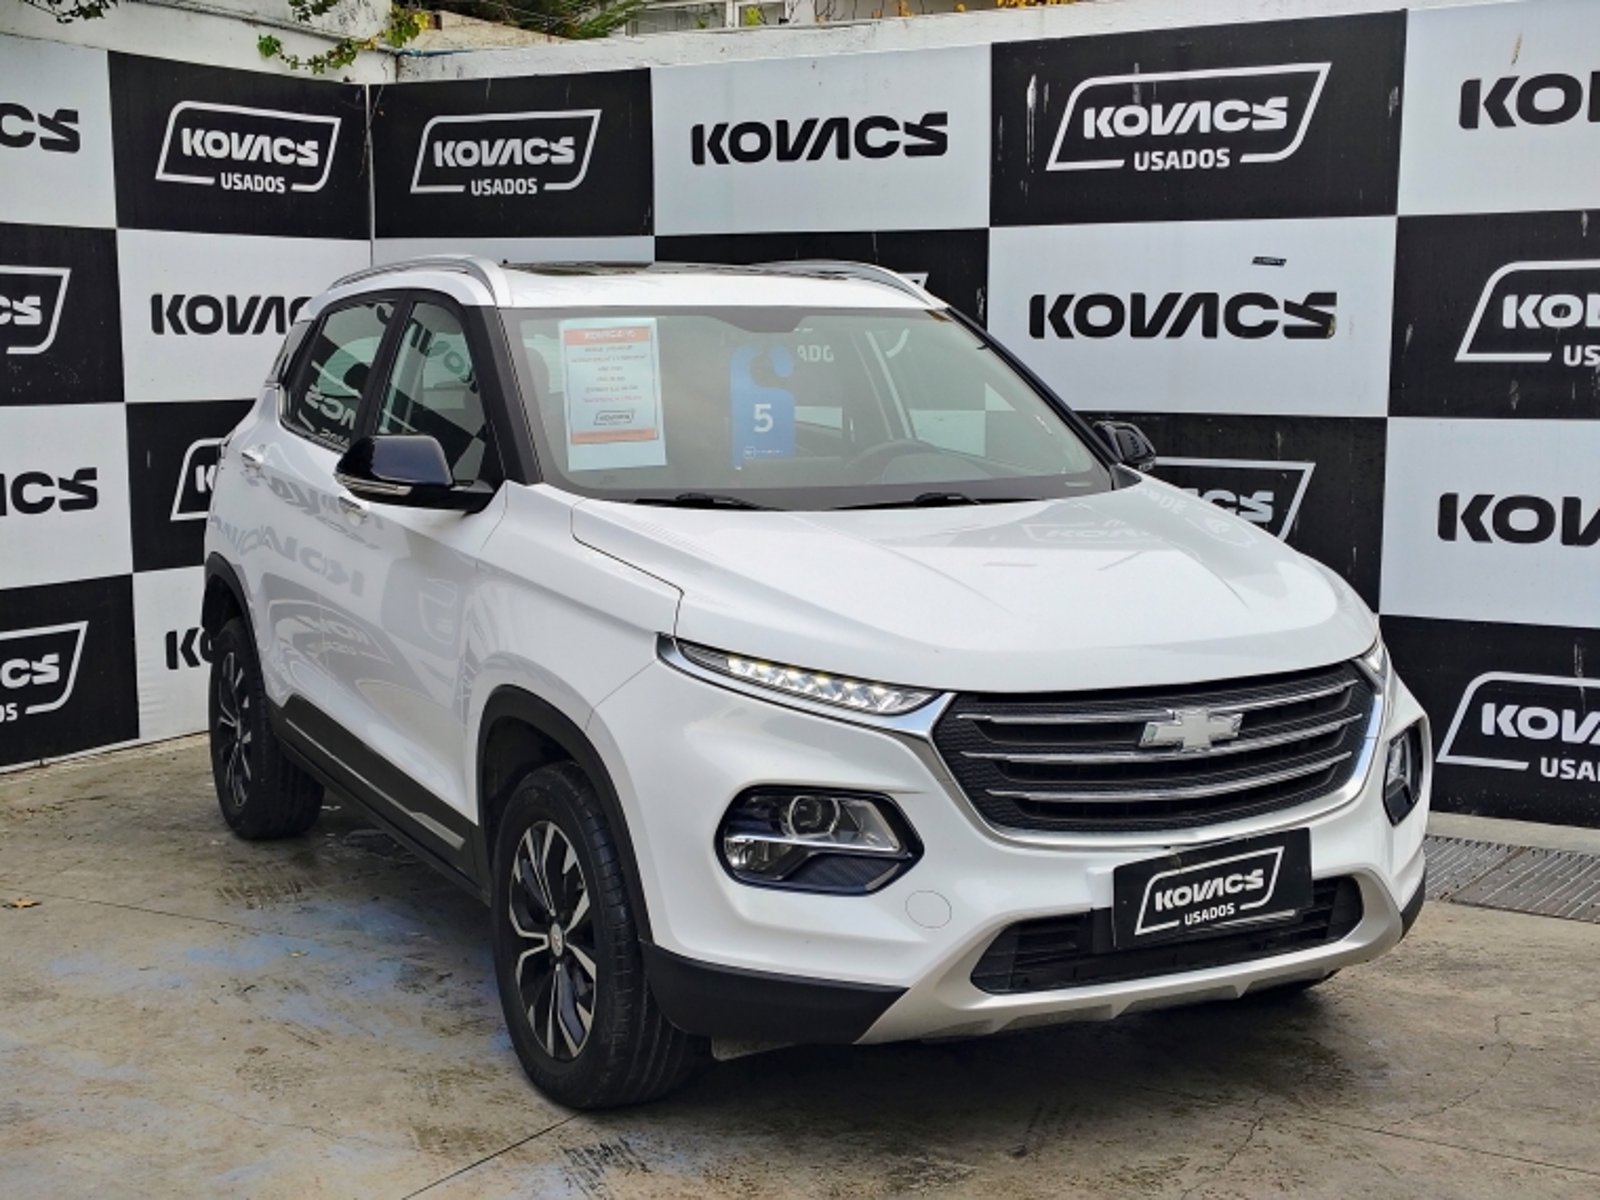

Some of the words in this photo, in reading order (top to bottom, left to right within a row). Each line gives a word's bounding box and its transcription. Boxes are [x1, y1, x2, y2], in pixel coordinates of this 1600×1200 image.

[1083, 96, 1289, 140] KOVACS
[181, 128, 320, 168] KOVACS
[433, 136, 576, 167] KOVACS
[691, 111, 949, 166] KOVACS
[1133, 148, 1231, 172] USADOS
[220, 172, 286, 194] USADOS
[470, 177, 538, 197] USADOS
[151, 293, 312, 336] KOVA
[1028, 291, 1338, 339] KOVACS
[753, 403, 774, 432] 5
[0, 466, 98, 516] CS
[1155, 868, 1264, 912] KOVACS
[1184, 902, 1236, 925] USADOS
